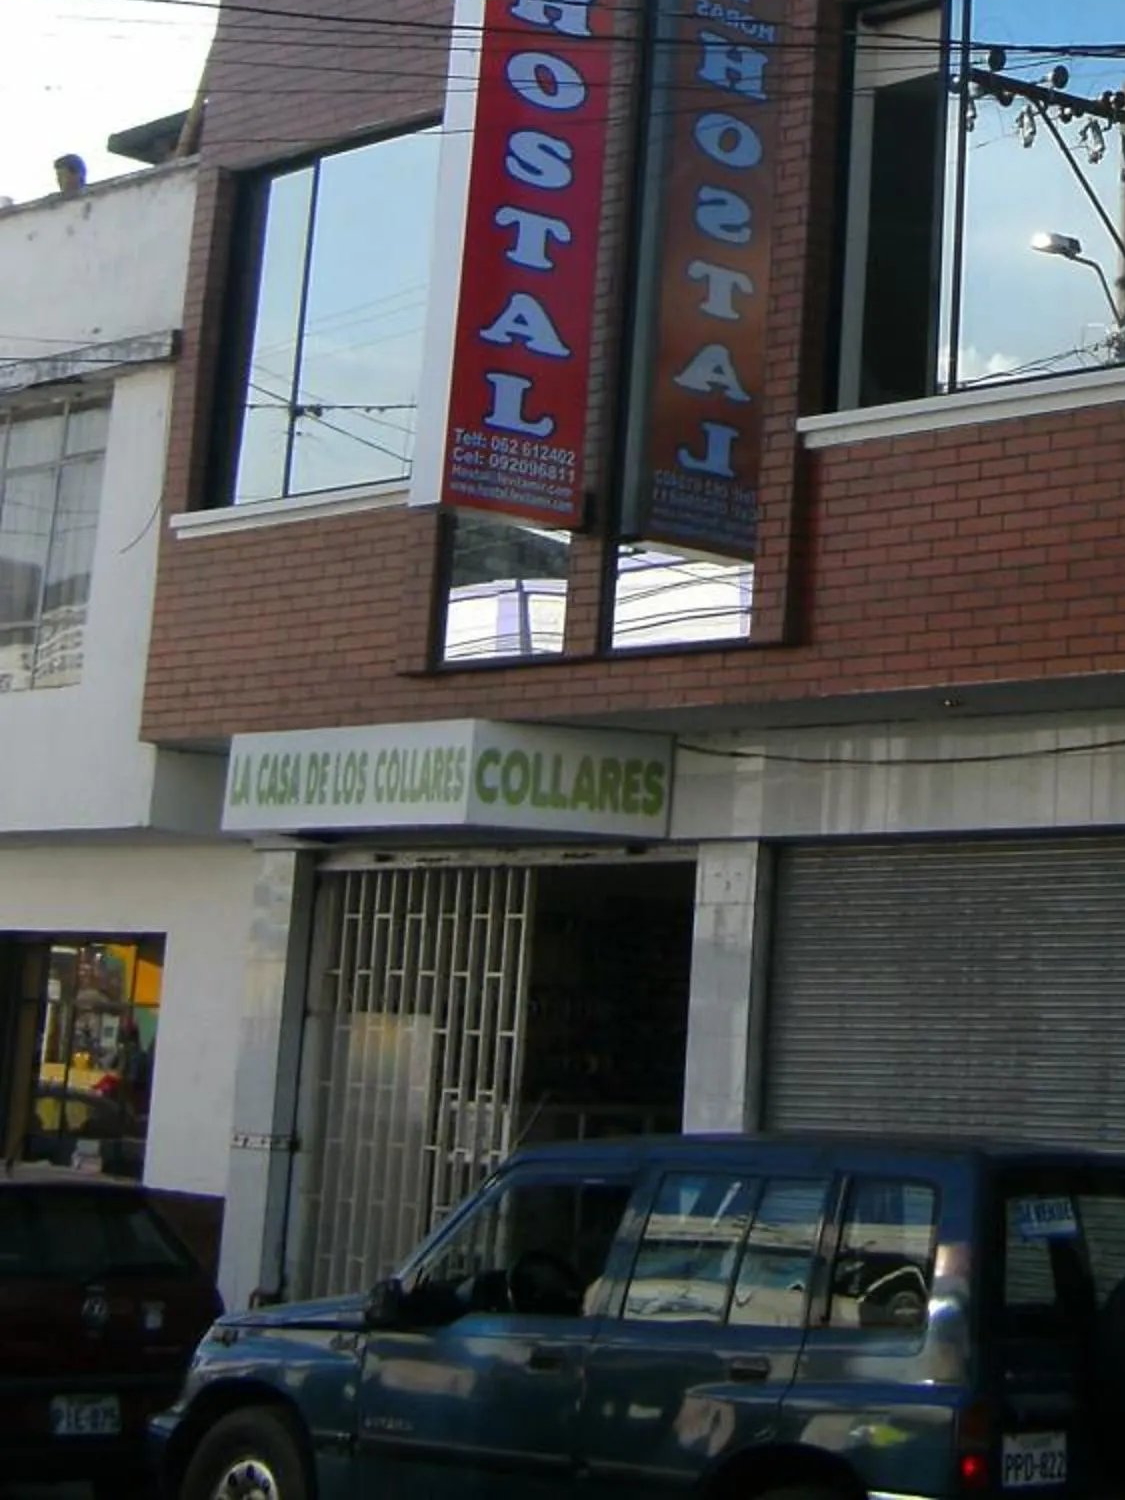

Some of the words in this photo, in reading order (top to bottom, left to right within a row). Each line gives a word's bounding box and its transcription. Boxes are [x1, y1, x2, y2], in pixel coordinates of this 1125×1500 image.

[453, 447, 485, 466] Cel:
[231, 753, 251, 807] LA
[257, 752, 300, 806] CASA
[305, 751, 332, 805] DE
[332, 750, 369, 804] LOS
[373, 746, 467, 804] COLLARES
[475, 747, 665, 818] COLLARES
